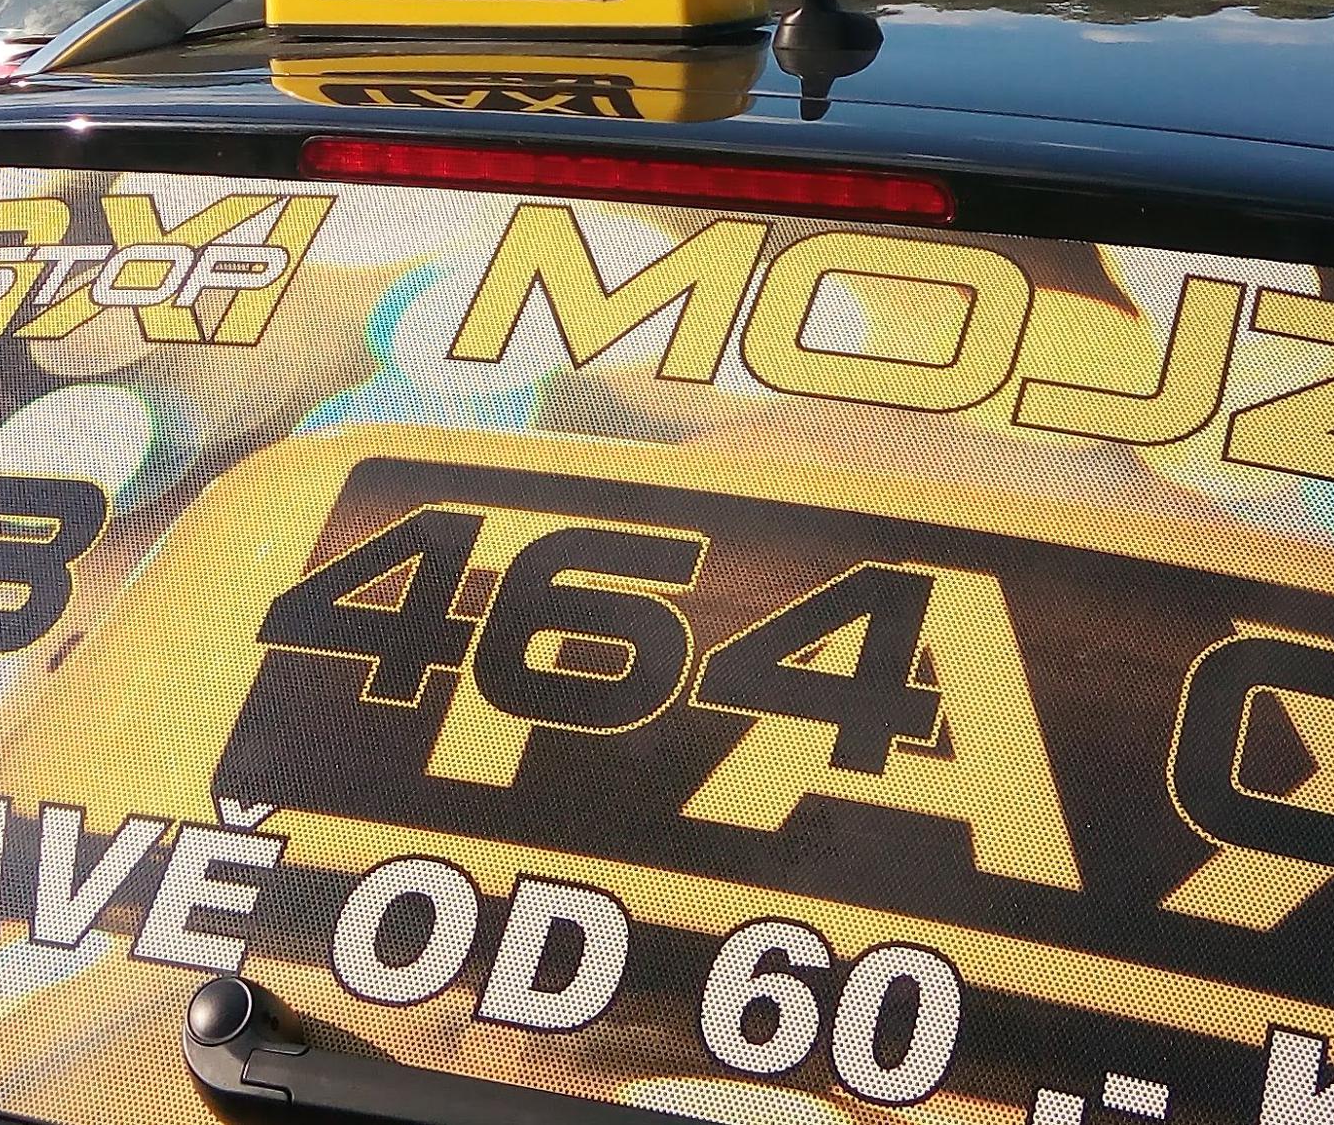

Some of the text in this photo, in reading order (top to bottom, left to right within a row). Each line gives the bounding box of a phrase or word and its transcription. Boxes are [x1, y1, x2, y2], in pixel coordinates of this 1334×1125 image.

[253, 502, 944, 776] 464
[330, 855, 633, 1032] OD
[698, 918, 964, 1107] 60
